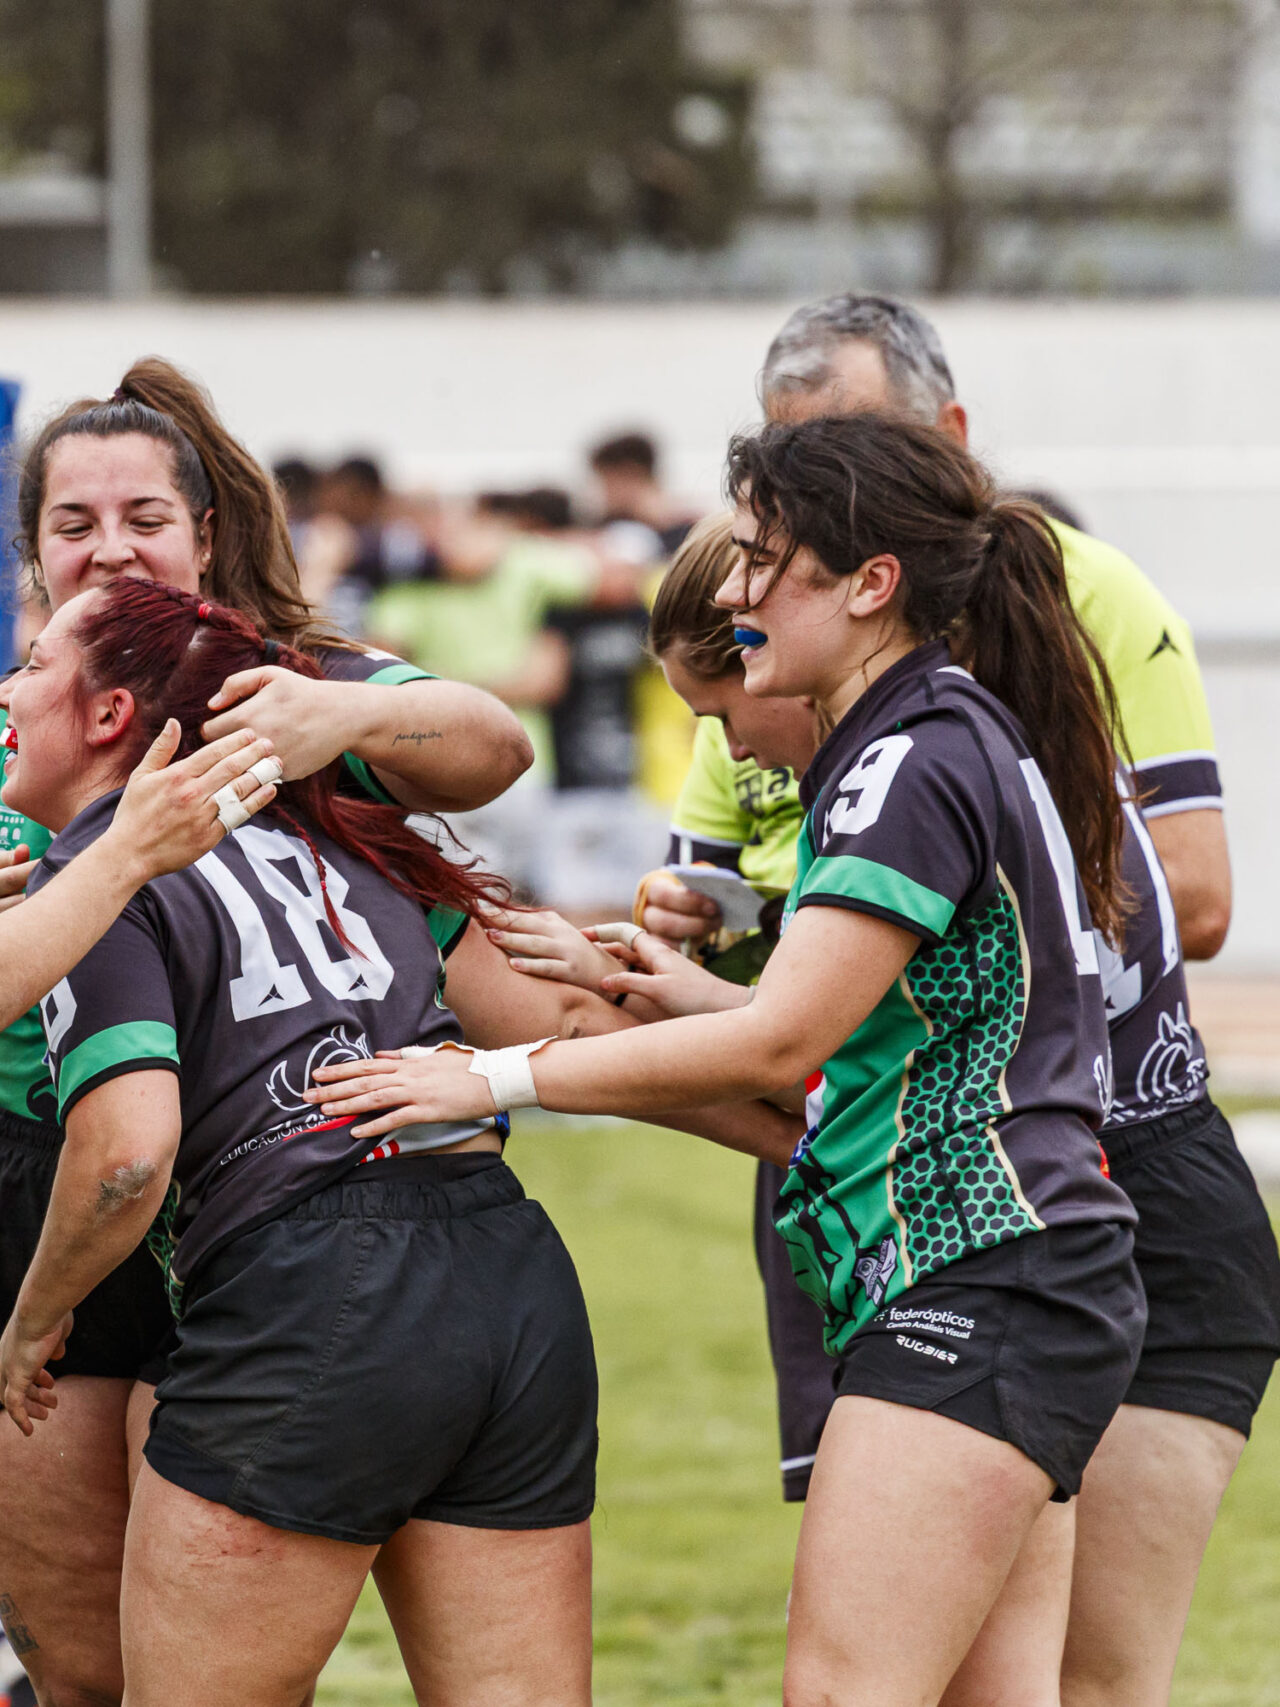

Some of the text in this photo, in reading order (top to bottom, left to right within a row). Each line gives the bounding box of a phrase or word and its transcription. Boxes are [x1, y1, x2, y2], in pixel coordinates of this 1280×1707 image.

[194, 824, 395, 1022] 18
[889, 1307, 976, 1330] federópticos
[895, 1334, 959, 1365] RUGBIER
